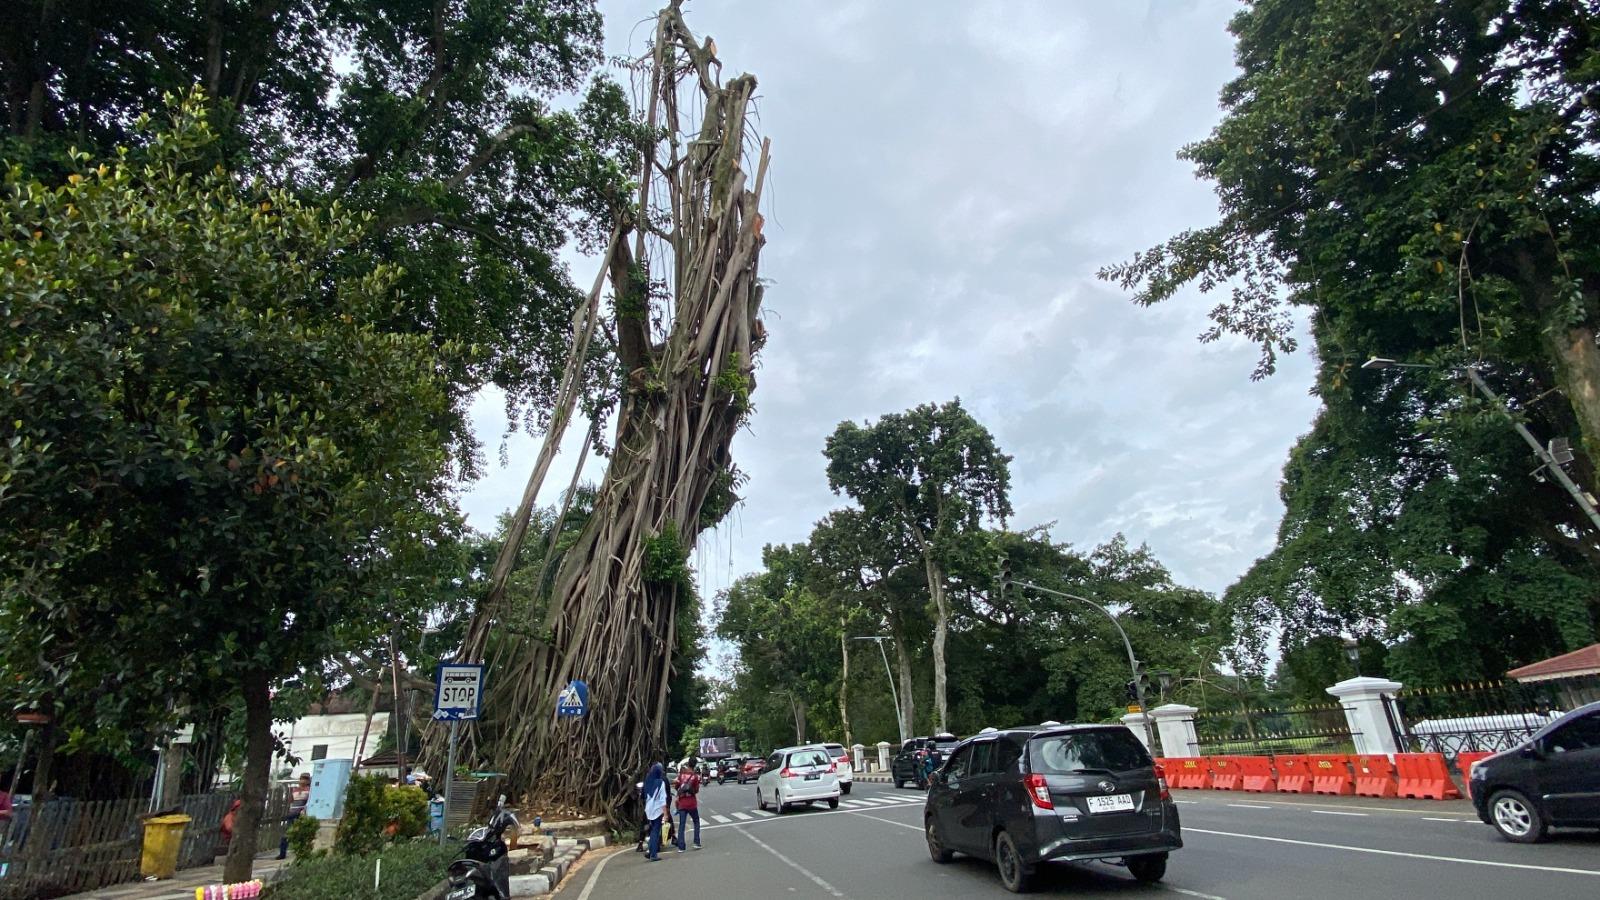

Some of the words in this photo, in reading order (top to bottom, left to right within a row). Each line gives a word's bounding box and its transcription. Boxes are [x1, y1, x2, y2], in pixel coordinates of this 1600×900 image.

[443, 687, 475, 702] STOP
[1088, 798, 1093, 807] F
[1097, 796, 1114, 806] 1525
